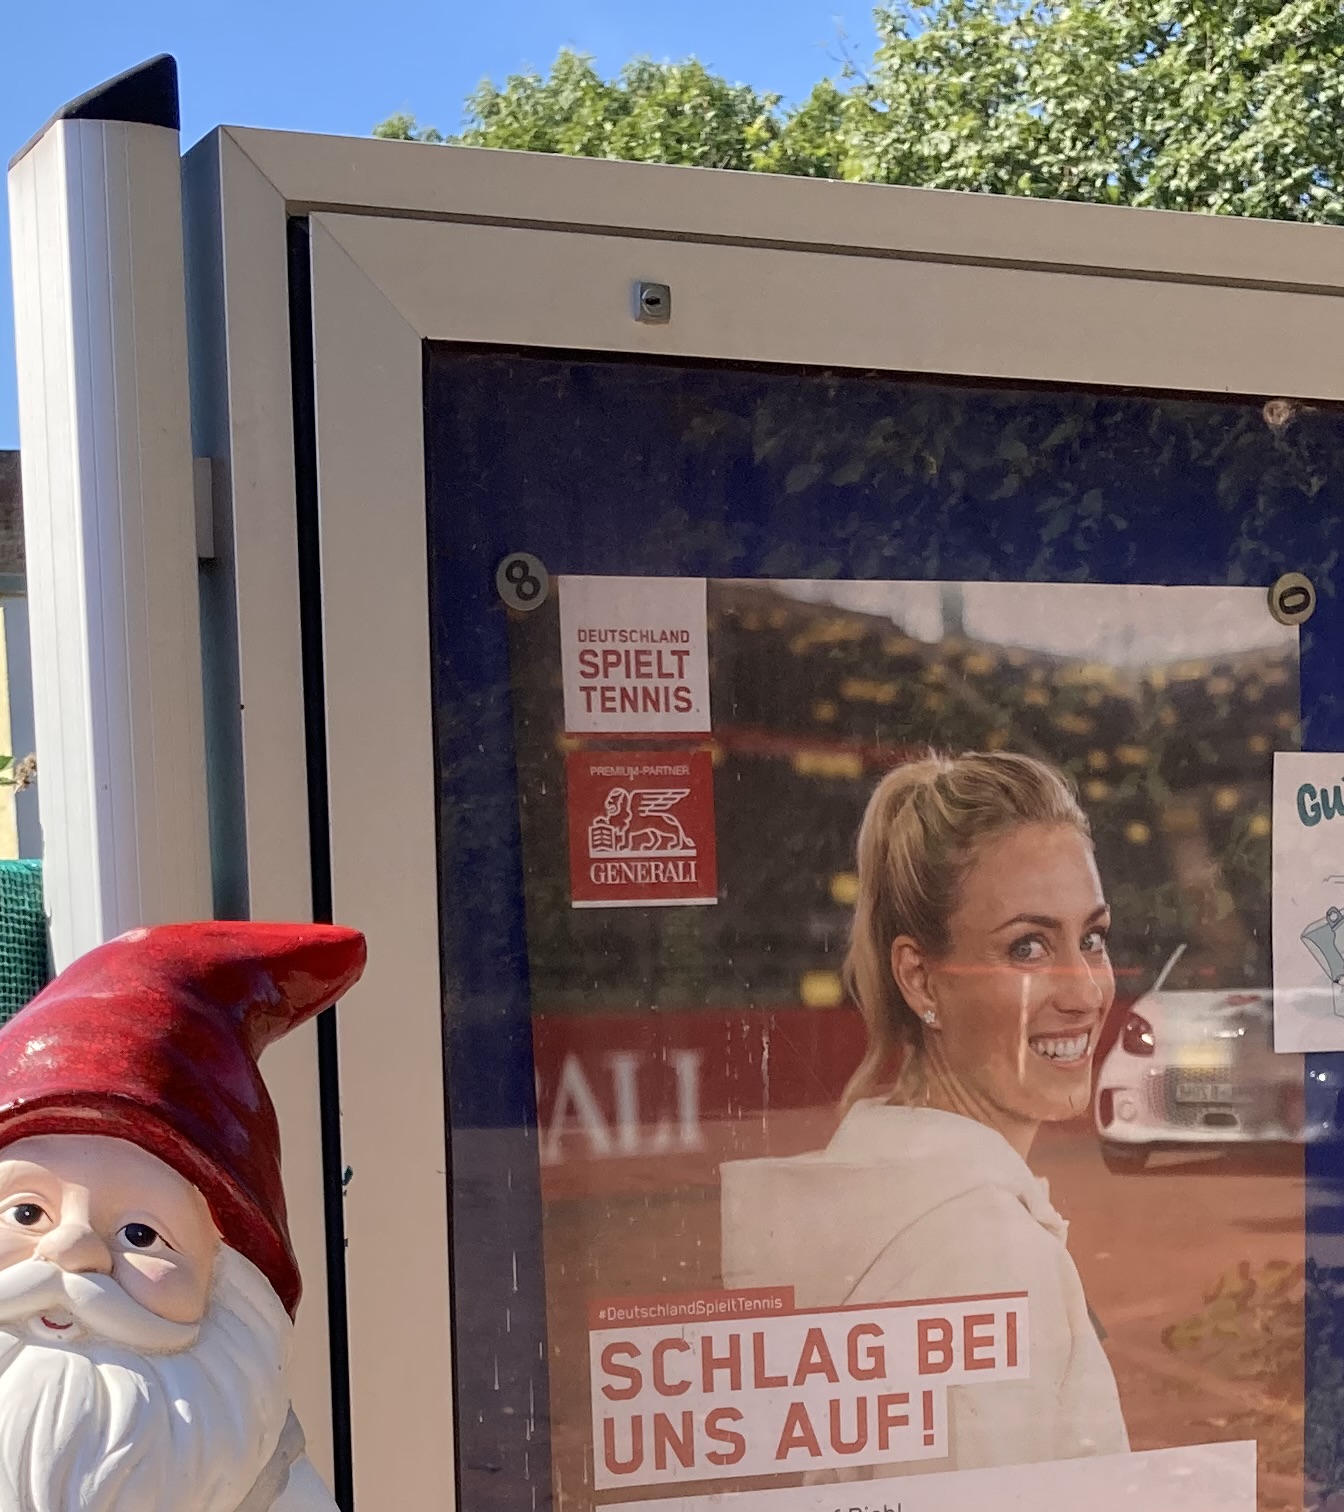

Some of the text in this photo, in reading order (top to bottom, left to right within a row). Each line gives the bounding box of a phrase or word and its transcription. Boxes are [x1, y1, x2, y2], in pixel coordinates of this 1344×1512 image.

[577, 629, 690, 643] DEUTSCHLAND
[579, 649, 690, 680] SPIELT
[579, 686, 693, 714] TENNIS
[590, 765, 690, 777] PREMIUM-PARTNER
[590, 861, 697, 884] GENERALI
[536, 1049, 705, 1167] ALI
[598, 1296, 783, 1322] #DeutschlandSpieltTennis
[600, 1311, 1018, 1401] SCHLAG BEI
[603, 1390, 935, 1474] UNS AUF!
